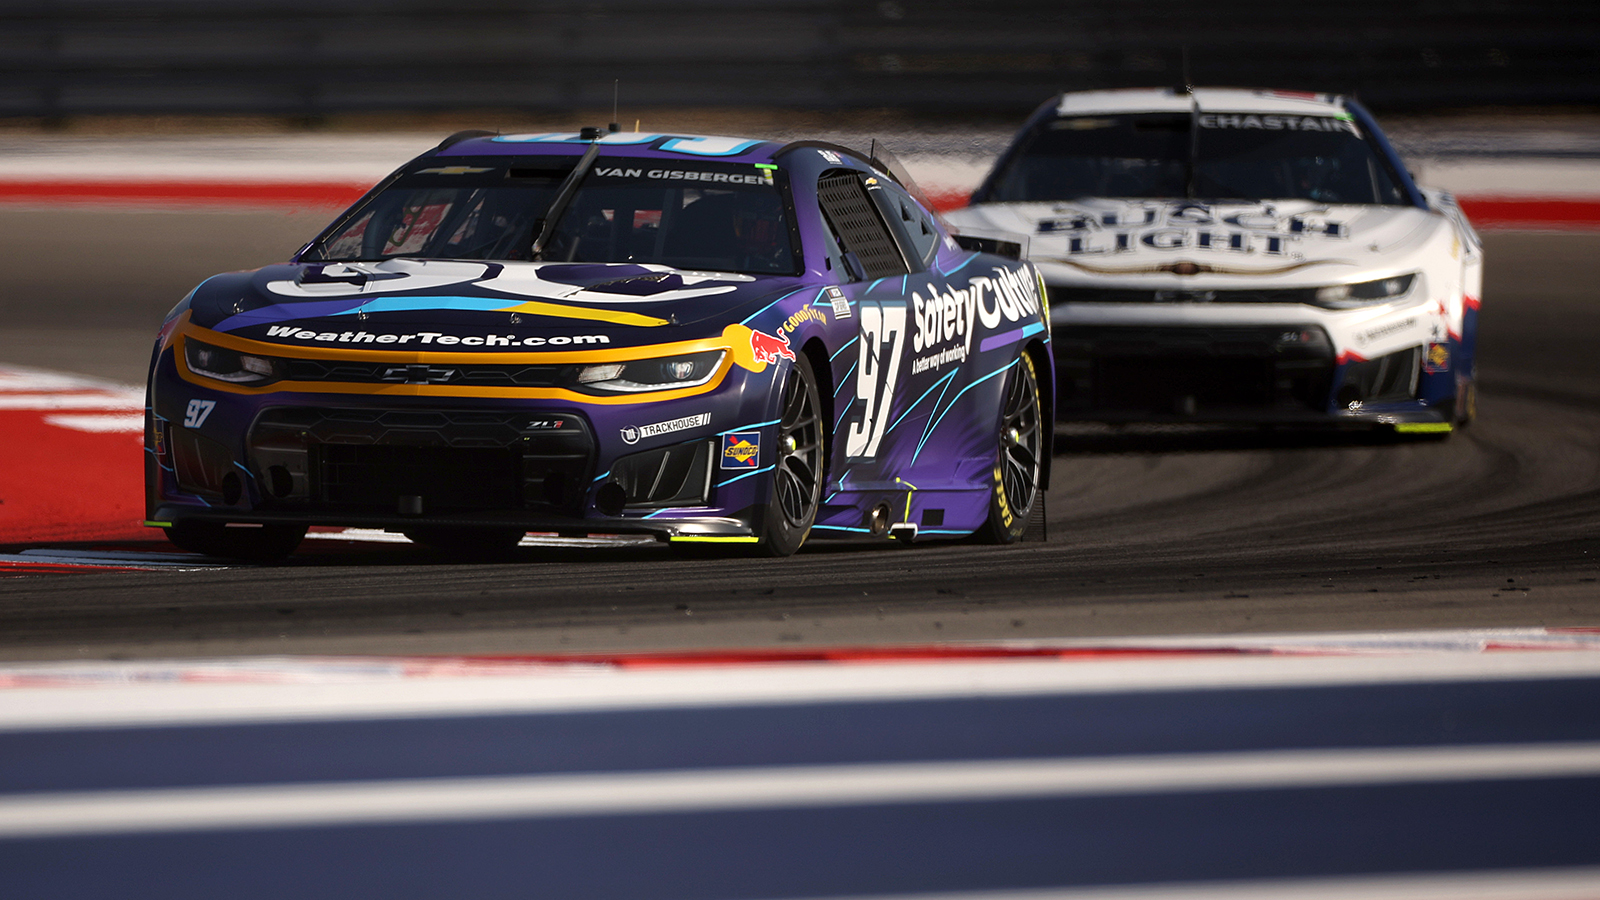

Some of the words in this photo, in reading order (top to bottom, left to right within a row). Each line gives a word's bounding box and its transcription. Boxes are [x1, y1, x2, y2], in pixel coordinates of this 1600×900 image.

[595, 168, 642, 178] VAN
[1069, 229, 1296, 254] LIGHT
[946, 343, 966, 363] working
[846, 306, 907, 457] 97
[184, 399, 217, 429] 97
[526, 420, 564, 429] ZL1
[643, 416, 700, 436] TRACKHOUSE
[726, 446, 758, 456] SUNOCO
[994, 467, 1013, 528] EAGLE
